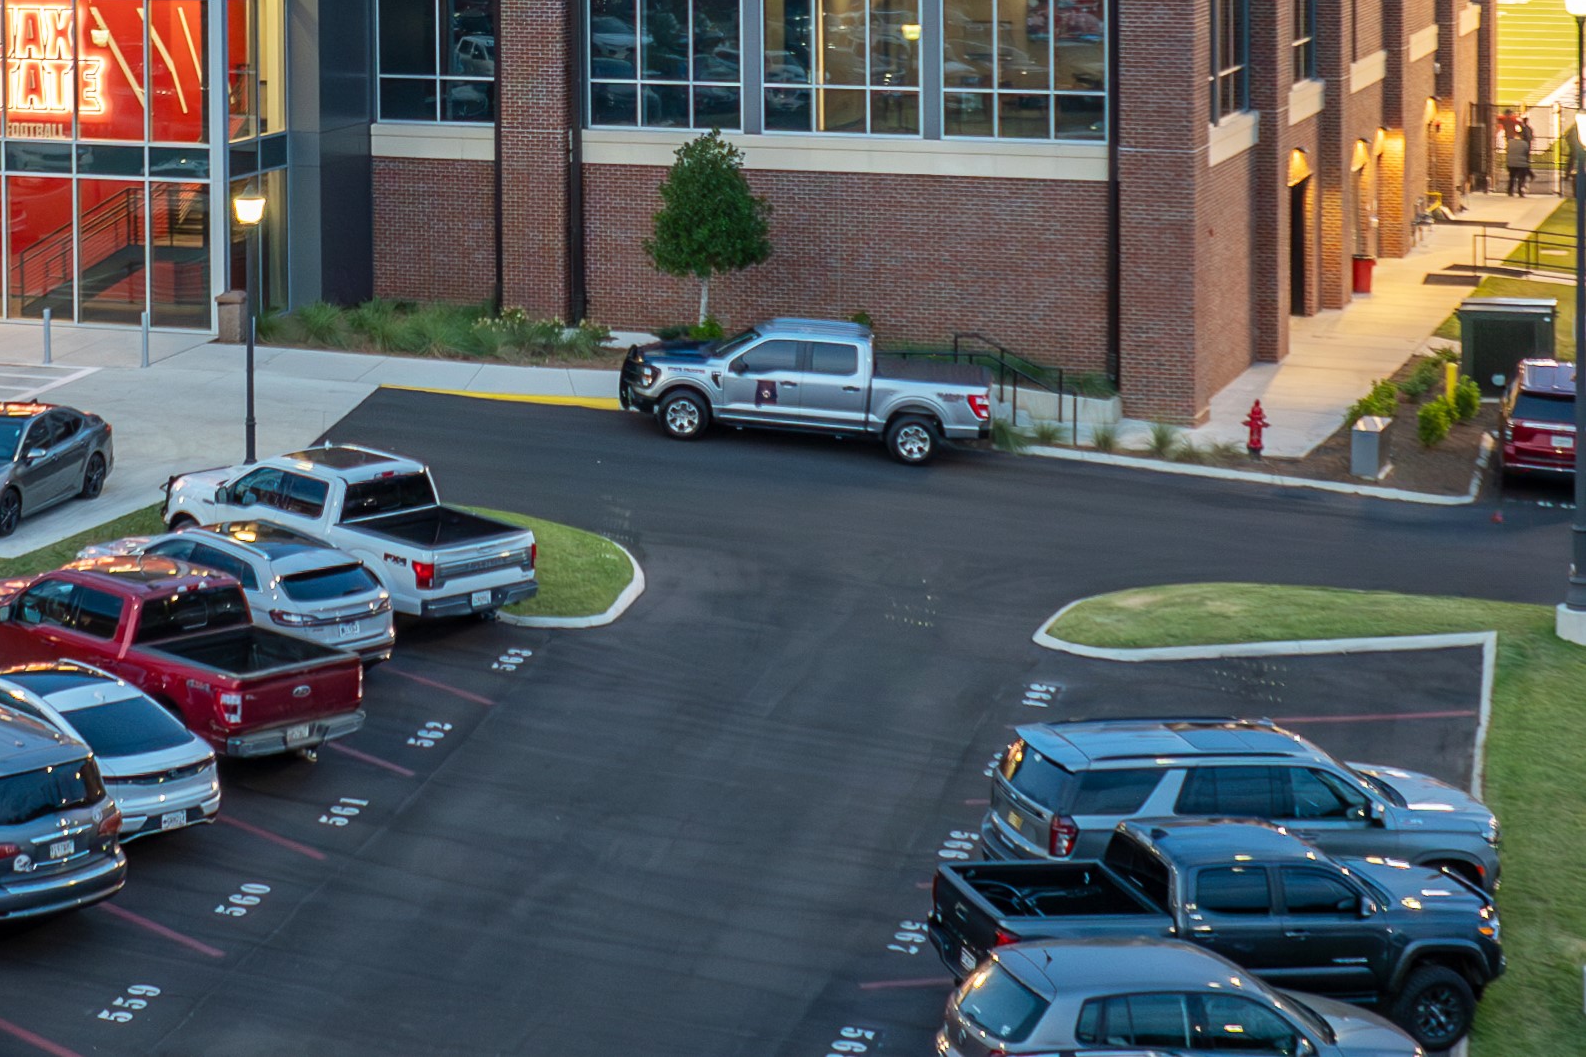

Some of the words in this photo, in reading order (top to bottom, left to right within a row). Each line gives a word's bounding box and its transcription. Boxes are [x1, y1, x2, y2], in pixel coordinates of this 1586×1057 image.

[491, 648, 533, 671] 563
[407, 721, 453, 748] 562
[318, 797, 369, 826] 561
[938, 830, 980, 860] 566
[214, 882, 271, 918] 560
[97, 983, 162, 1024] 559
[825, 1027, 875, 1057] 56
